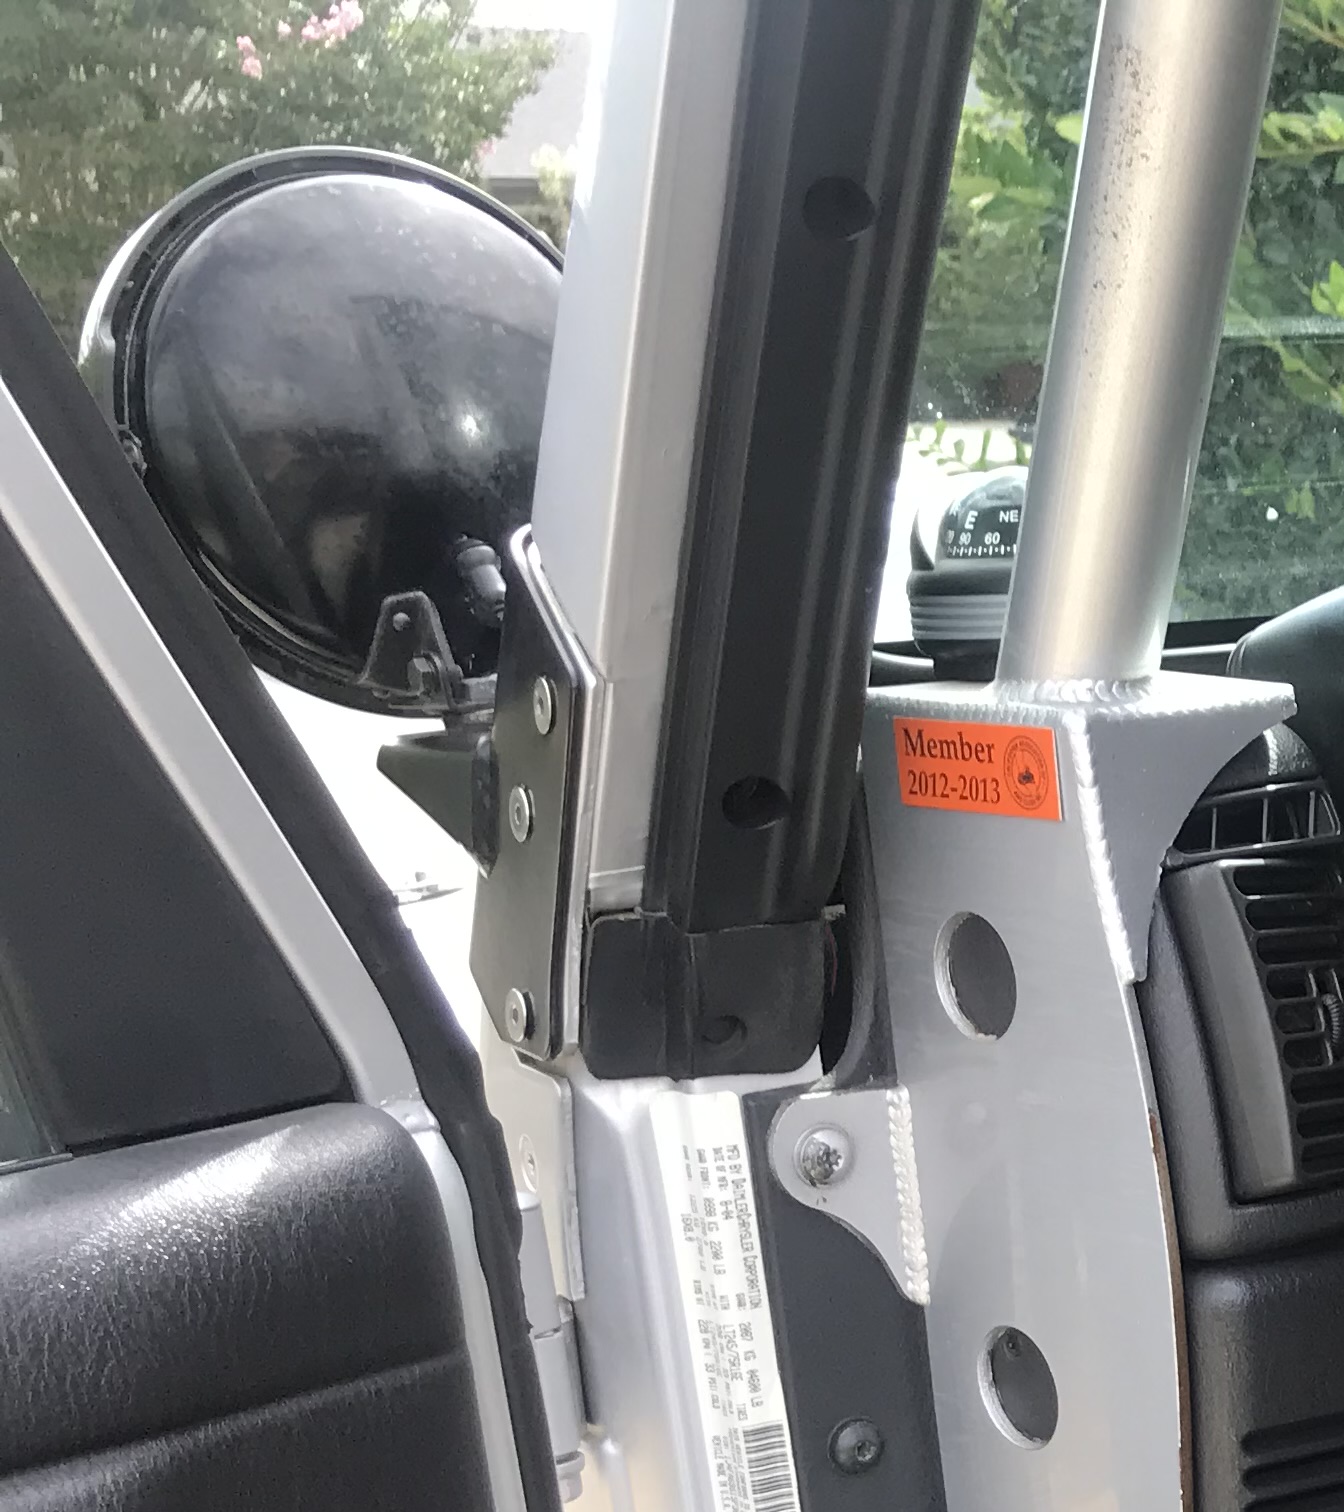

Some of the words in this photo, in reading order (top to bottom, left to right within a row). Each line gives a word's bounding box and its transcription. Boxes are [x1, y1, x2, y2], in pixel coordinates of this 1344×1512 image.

[964, 510, 978, 530] E
[999, 509, 1019, 523] NE
[984, 531, 1001, 545] 60
[903, 727, 995, 764] Member
[908, 769, 1001, 804] 2012-2013
